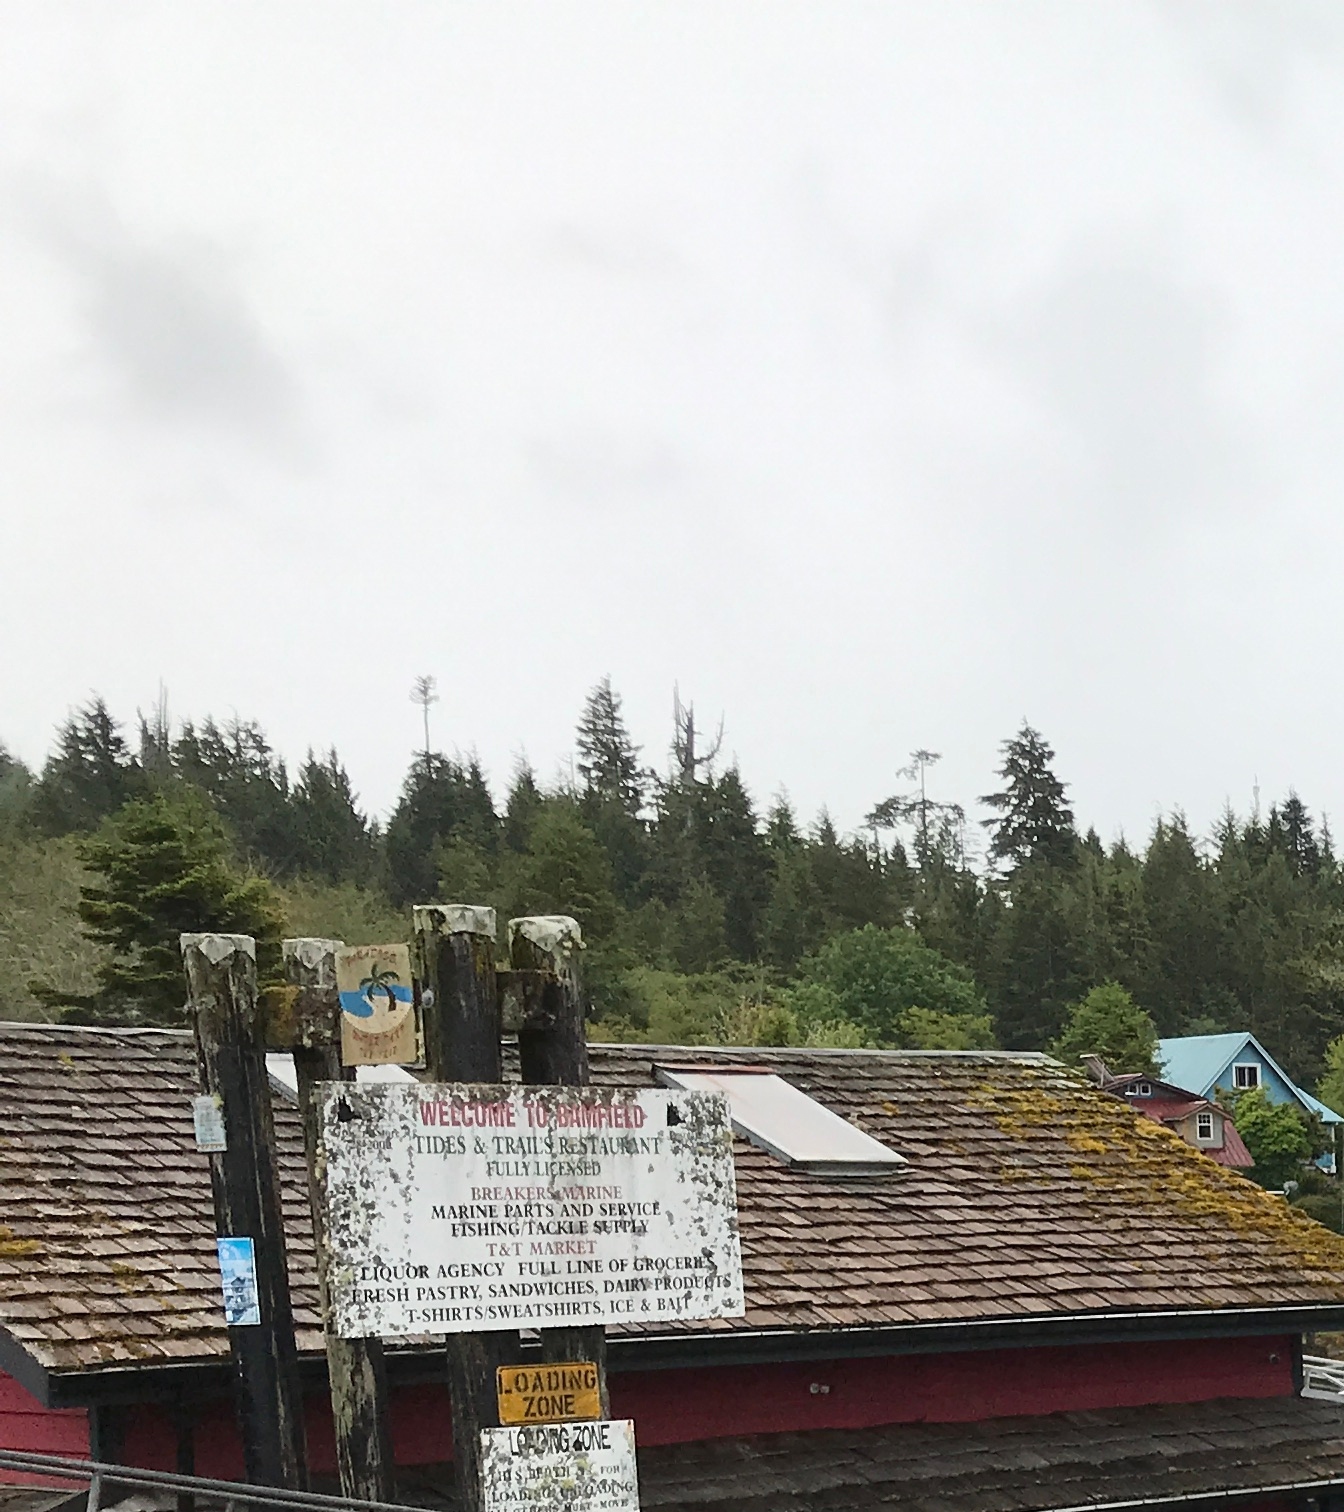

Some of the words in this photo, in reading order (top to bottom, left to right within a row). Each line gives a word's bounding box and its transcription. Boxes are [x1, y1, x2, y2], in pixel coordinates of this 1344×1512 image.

[420, 1101, 516, 1127] WELCOME
[523, 1102, 548, 1128] TO
[558, 1103, 645, 1129] BAMFIELD
[414, 1135, 466, 1154] TIDES
[474, 1135, 485, 1154] &
[560, 1135, 661, 1155] RESTAURANT
[486, 1161, 530, 1177] FULLY
[537, 1160, 601, 1177] LICENSED
[471, 1187, 555, 1201] BREAKERS
[562, 1185, 623, 1201] MARINE
[431, 1204, 499, 1220] MARINE
[504, 1202, 554, 1219] PARTS
[560, 1203, 594, 1218] AND
[600, 1201, 661, 1217] SERVICE
[451, 1220, 588, 1238] FISHING/TACKLE
[594, 1219, 649, 1236] SUPPLY
[486, 1242, 523, 1257] T&T
[530, 1240, 597, 1257] MARKET
[361, 1264, 430, 1284] LIQUOR
[437, 1262, 506, 1279] AGENCY
[519, 1261, 561, 1277] FULL
[567, 1259, 603, 1275] LINE
[609, 1258, 630, 1273] OF
[633, 1255, 715, 1273] GROCERIES
[352, 1287, 410, 1304] FRESH
[416, 1284, 483, 1301] PASTRY,
[488, 1280, 599, 1299] SANDWICHES,
[604, 1278, 651, 1294] DAIRY
[654, 1274, 732, 1292] PRODUCTS
[406, 1302, 605, 1323] T-SHIRTS/SWEATSHIRTS,
[611, 1299, 635, 1314] ICE
[641, 1298, 652, 1313] &
[657, 1296, 690, 1312] BAIT
[499, 1369, 597, 1395] LOADING
[522, 1394, 576, 1418] ZONE
[572, 1424, 612, 1451] ZONE
